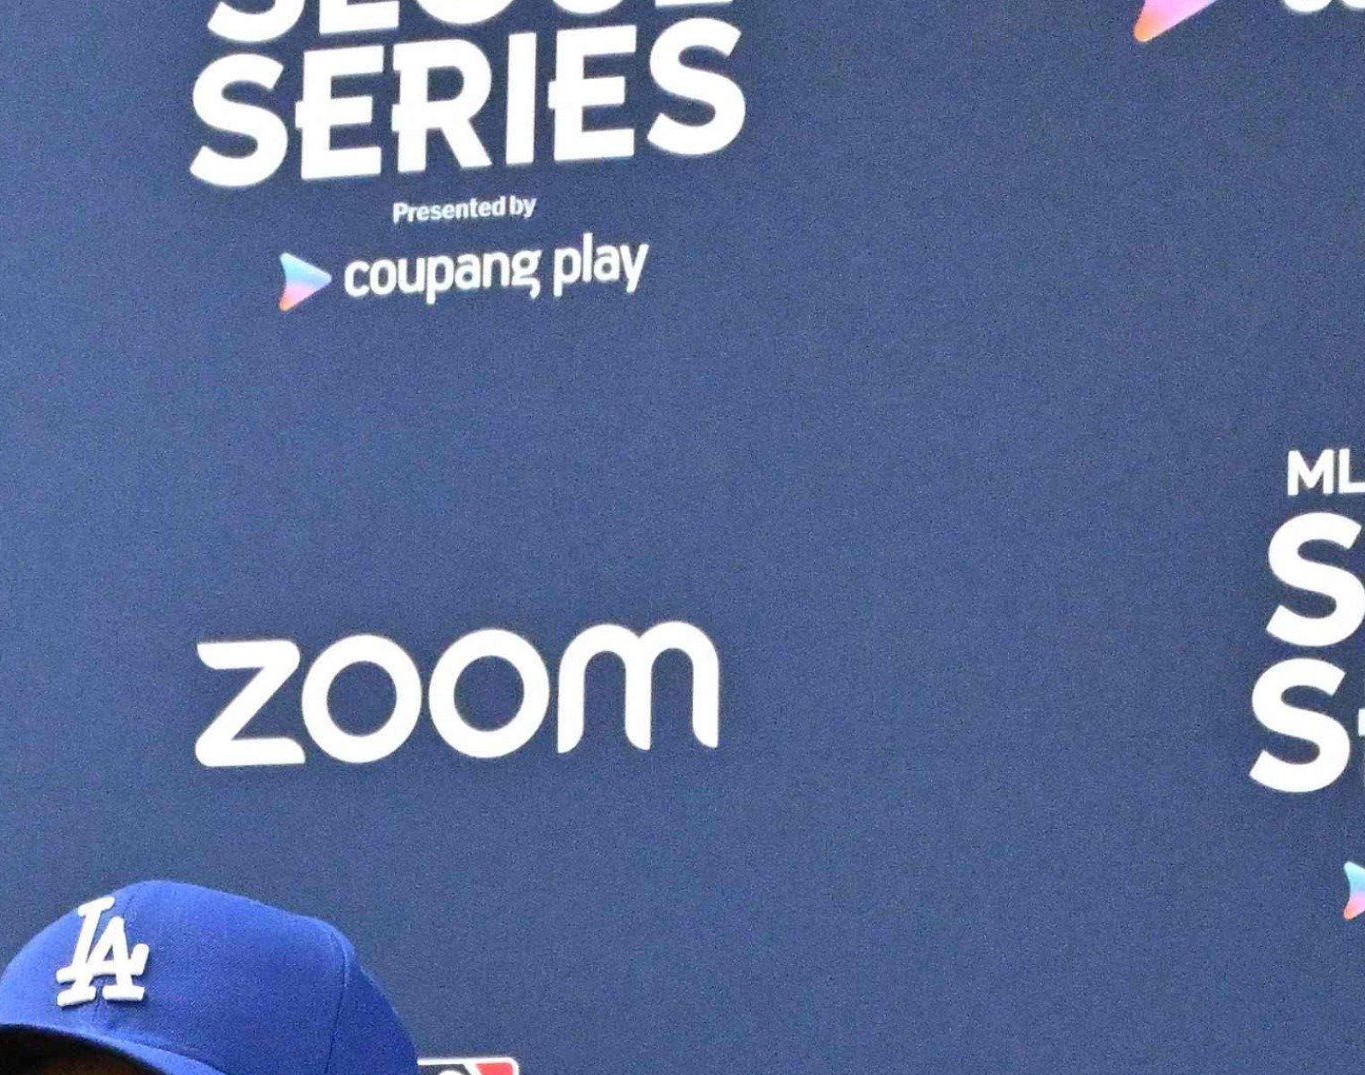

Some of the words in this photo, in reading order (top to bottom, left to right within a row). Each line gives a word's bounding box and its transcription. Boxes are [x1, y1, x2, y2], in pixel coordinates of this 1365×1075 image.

[190, 17, 746, 187] SERIES
[393, 197, 506, 223] Presented
[508, 195, 537, 220] by
[344, 250, 544, 304] coupang
[553, 232, 650, 298] play
[1287, 448, 1365, 496] ML
[56, 897, 149, 1007] LA
